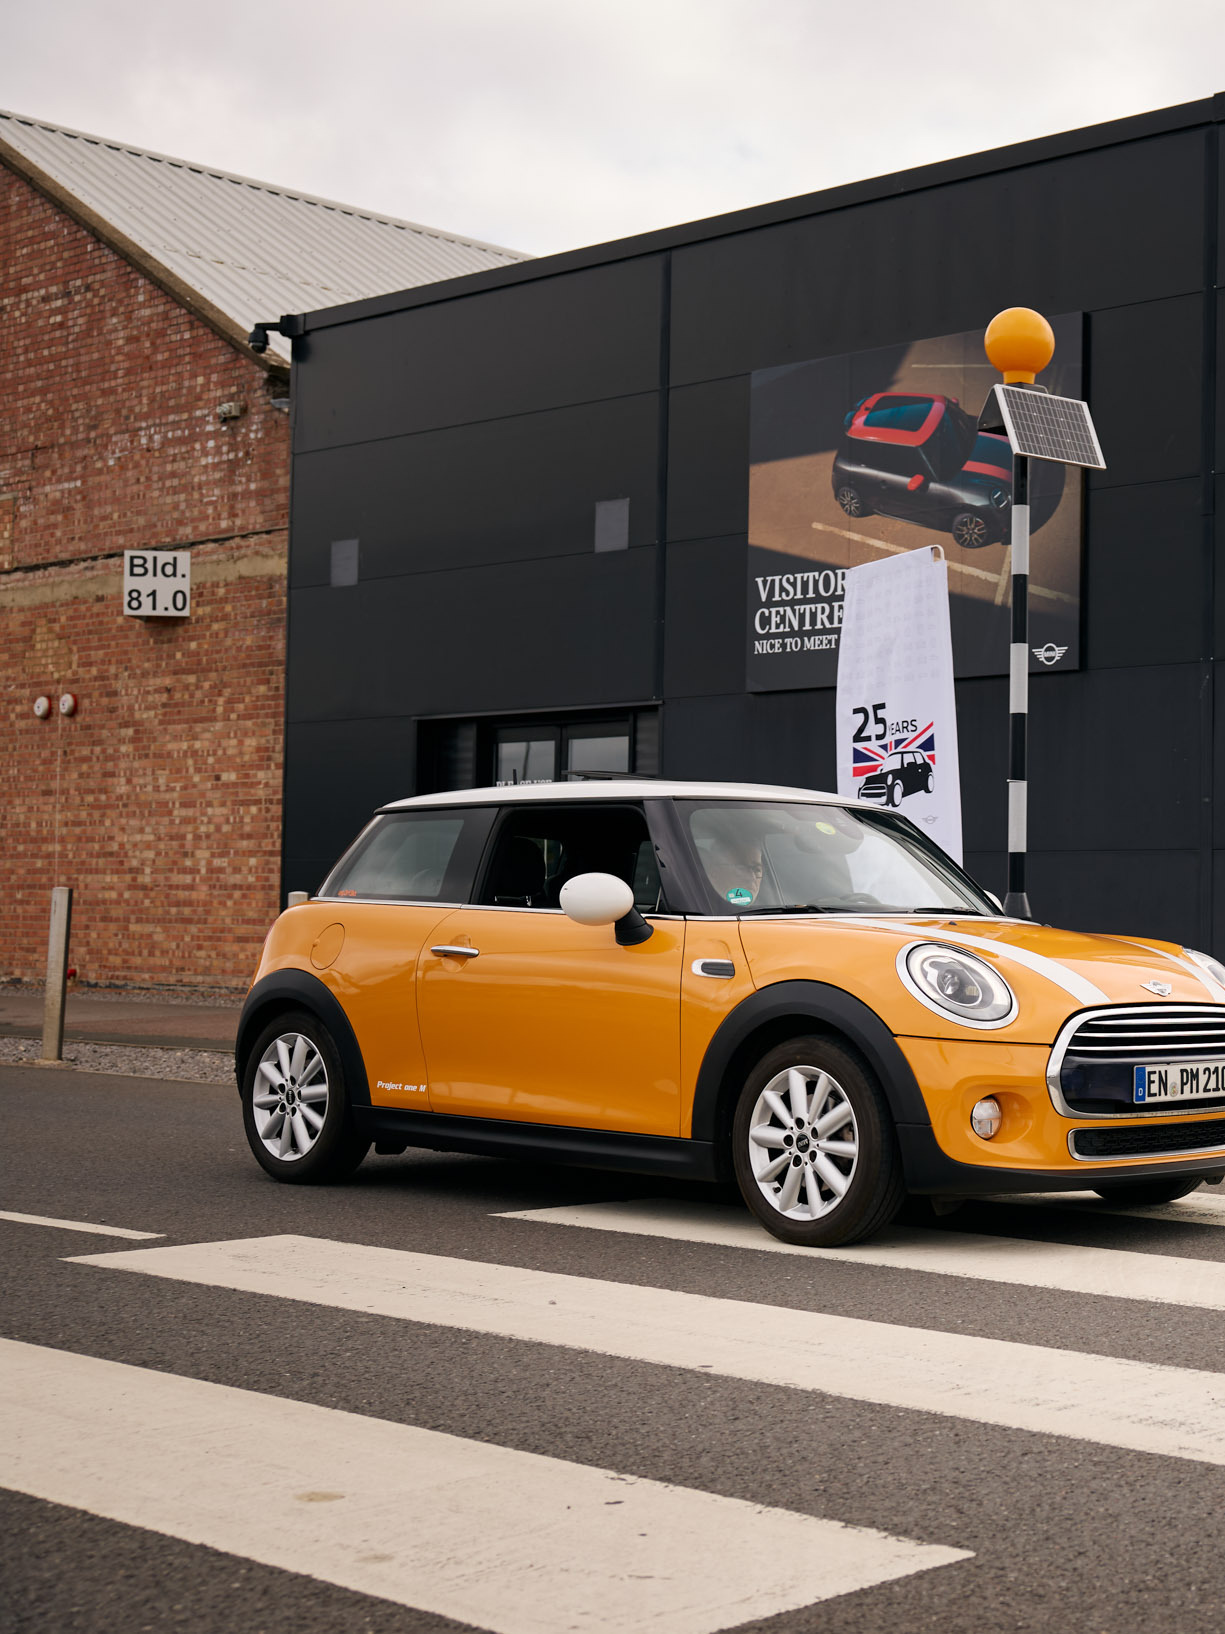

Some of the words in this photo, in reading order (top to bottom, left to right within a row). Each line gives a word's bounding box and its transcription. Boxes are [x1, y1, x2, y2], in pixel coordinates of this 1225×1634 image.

[129, 555, 186, 578] Bld.
[755, 568, 846, 602] VISITOR
[127, 588, 187, 612] 81.0
[754, 601, 844, 634] CENTRE
[754, 639, 782, 654] NICE
[784, 637, 801, 652] TO
[803, 634, 838, 650] MEET
[852, 702, 887, 743] 25
[377, 1081, 402, 1090] Project
[1147, 1070, 1168, 1097] EN
[1180, 1068, 1199, 1095] PM
